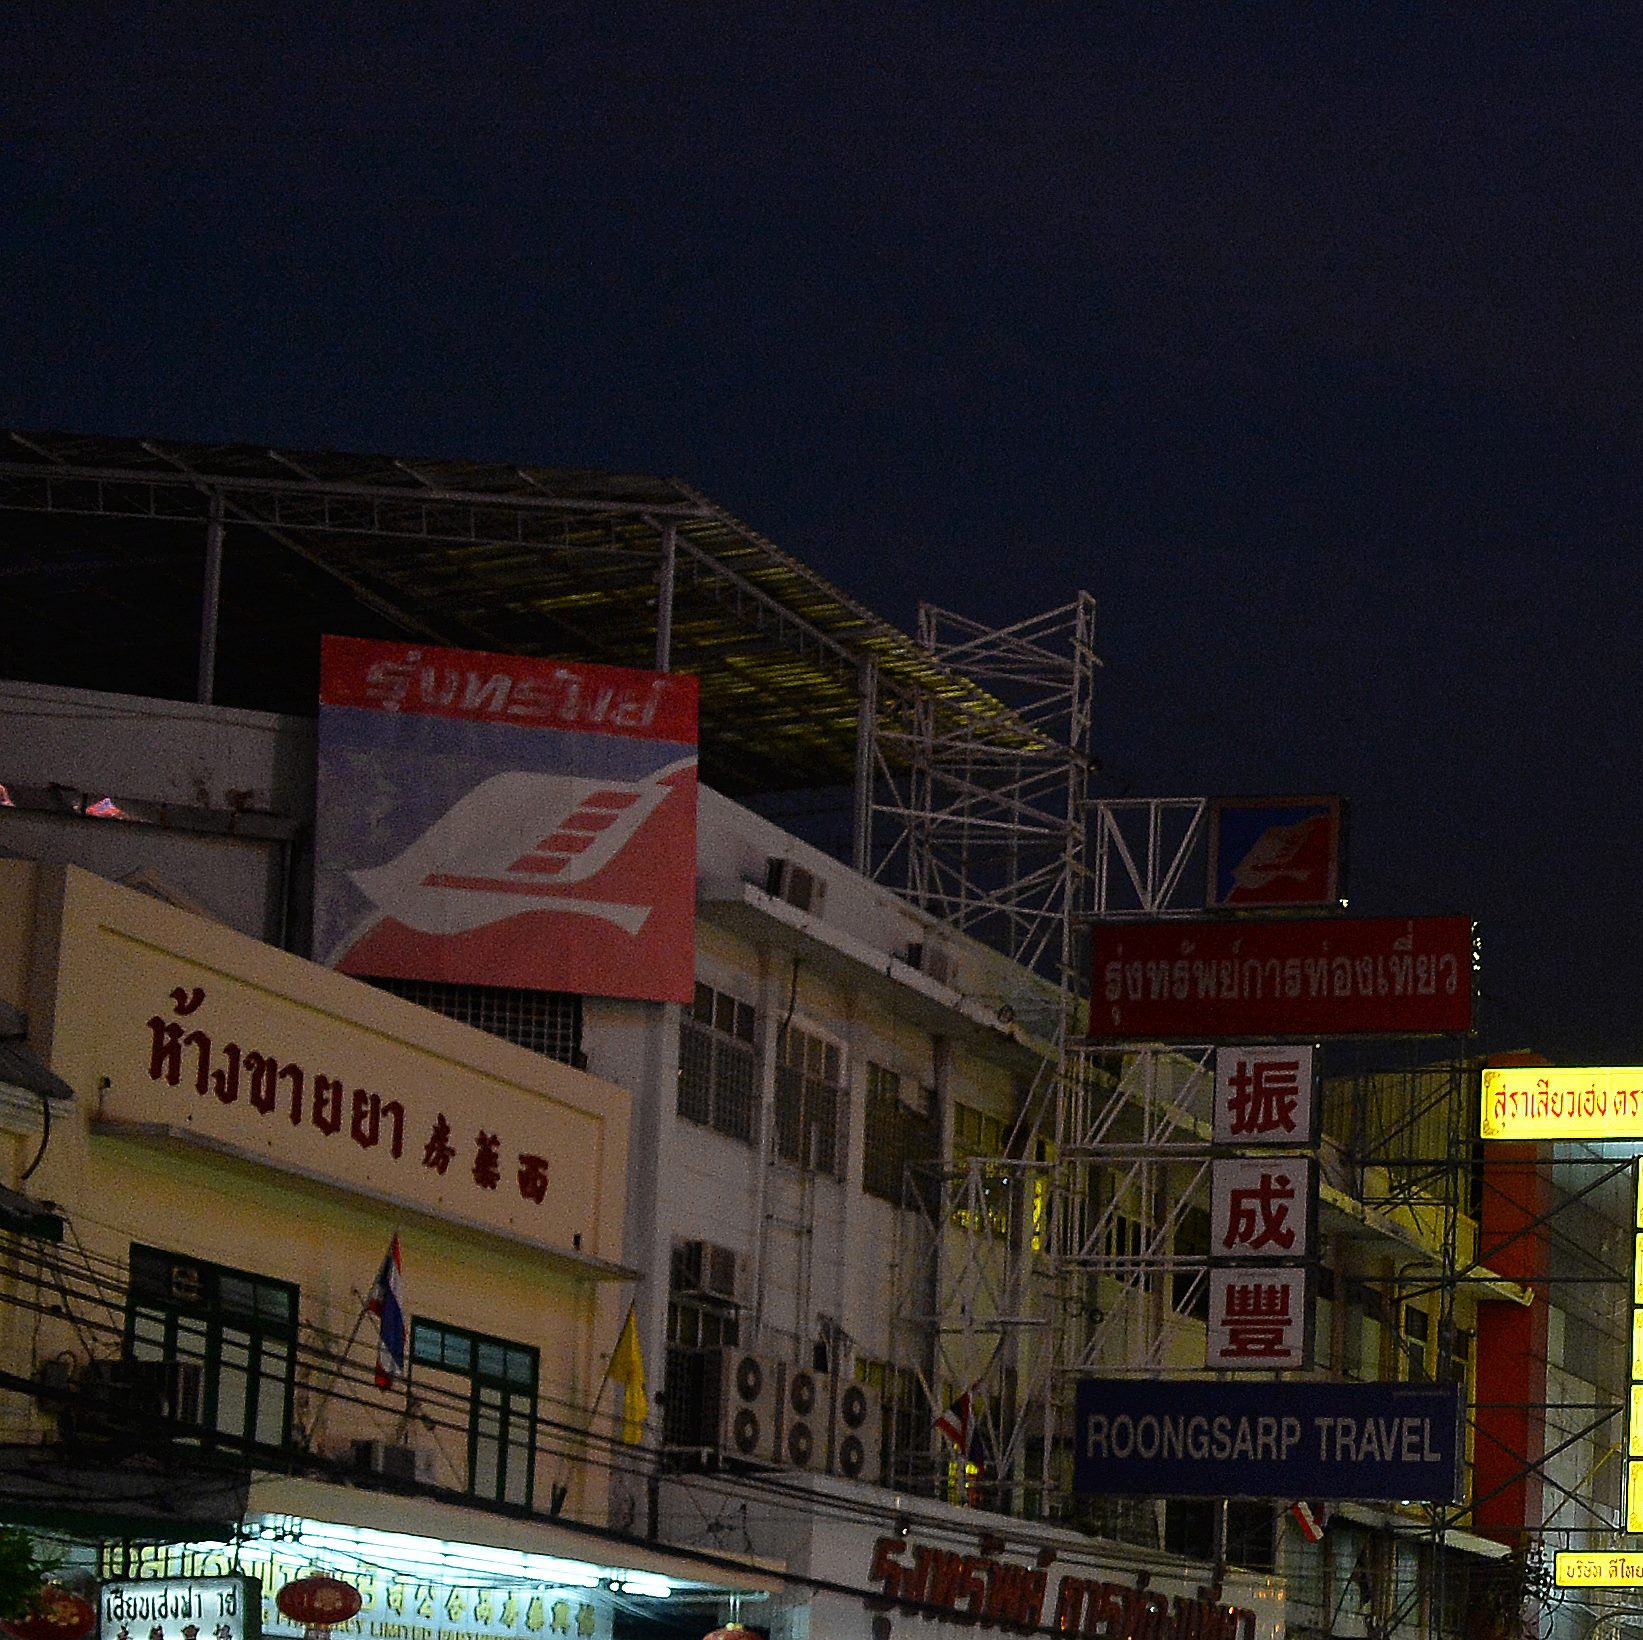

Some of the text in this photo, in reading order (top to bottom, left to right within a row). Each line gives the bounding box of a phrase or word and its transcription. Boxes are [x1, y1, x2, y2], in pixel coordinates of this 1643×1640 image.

[146, 986, 405, 1160] ห้างขายยา
[1086, 1414, 1441, 1463] ROONGSARP TRAVEL
